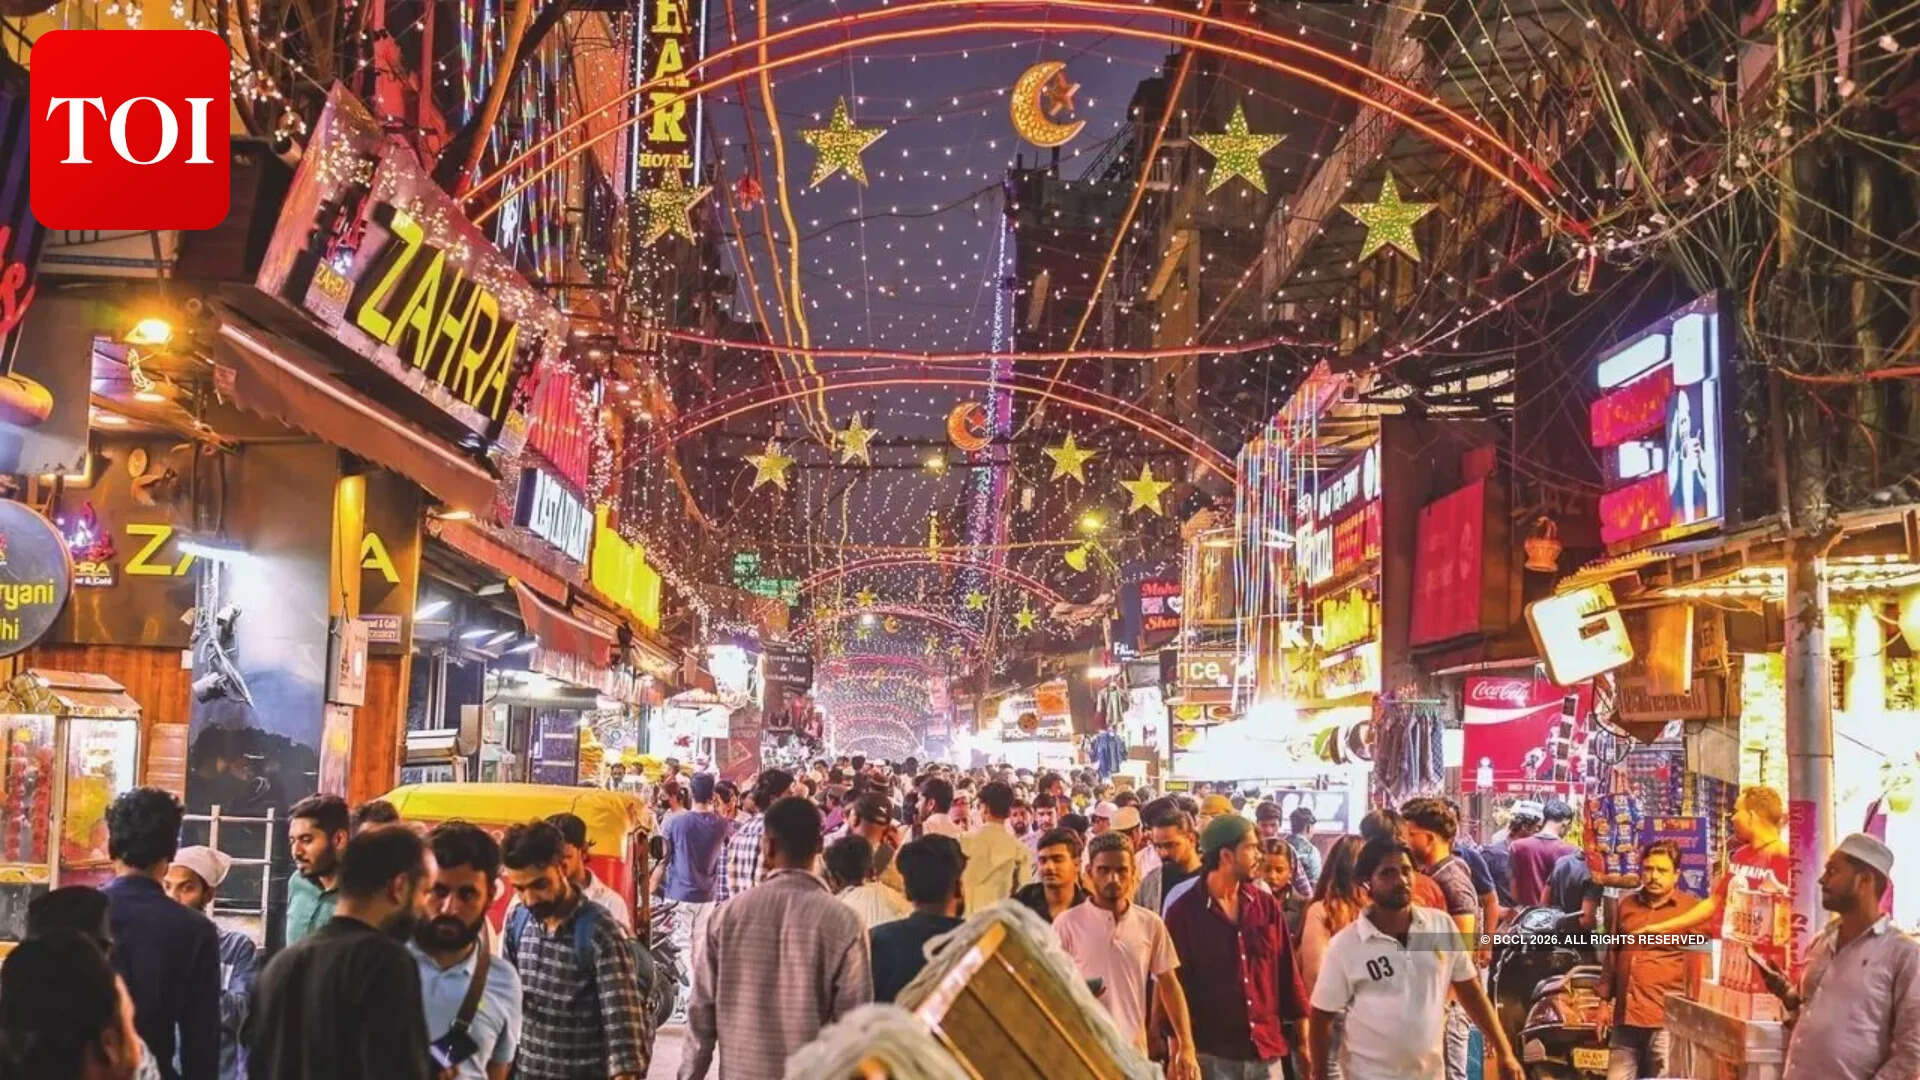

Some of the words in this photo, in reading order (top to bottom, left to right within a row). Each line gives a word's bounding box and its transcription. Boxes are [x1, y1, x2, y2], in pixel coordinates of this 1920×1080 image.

[639, 154, 694, 168] HOTEL
[357, 208, 520, 422] ZAHRA
[1366, 956, 1394, 981] 03
